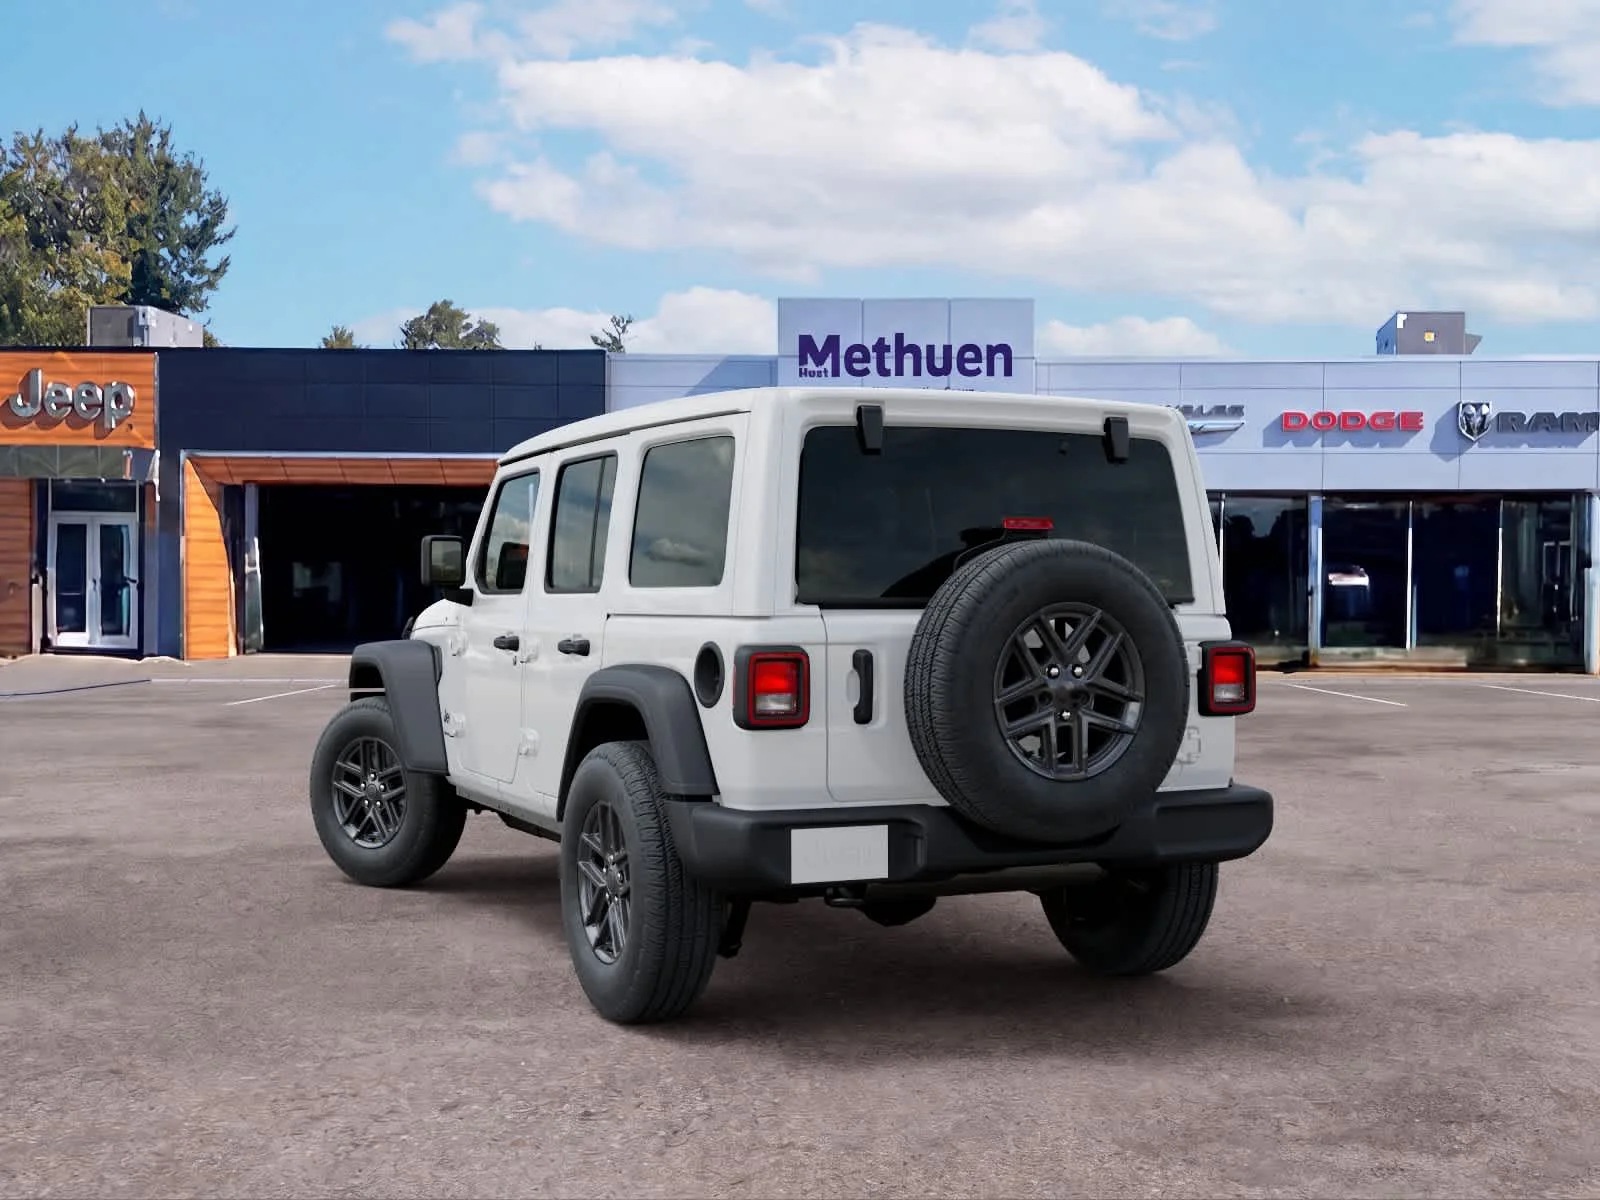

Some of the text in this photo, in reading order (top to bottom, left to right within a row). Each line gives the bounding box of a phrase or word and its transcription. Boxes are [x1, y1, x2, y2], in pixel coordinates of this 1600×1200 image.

[798, 333, 1013, 377] Methuen
[9, 368, 135, 429] Jeep
[1282, 411, 1424, 431] DODGE
[1497, 411, 1600, 433] RAM
